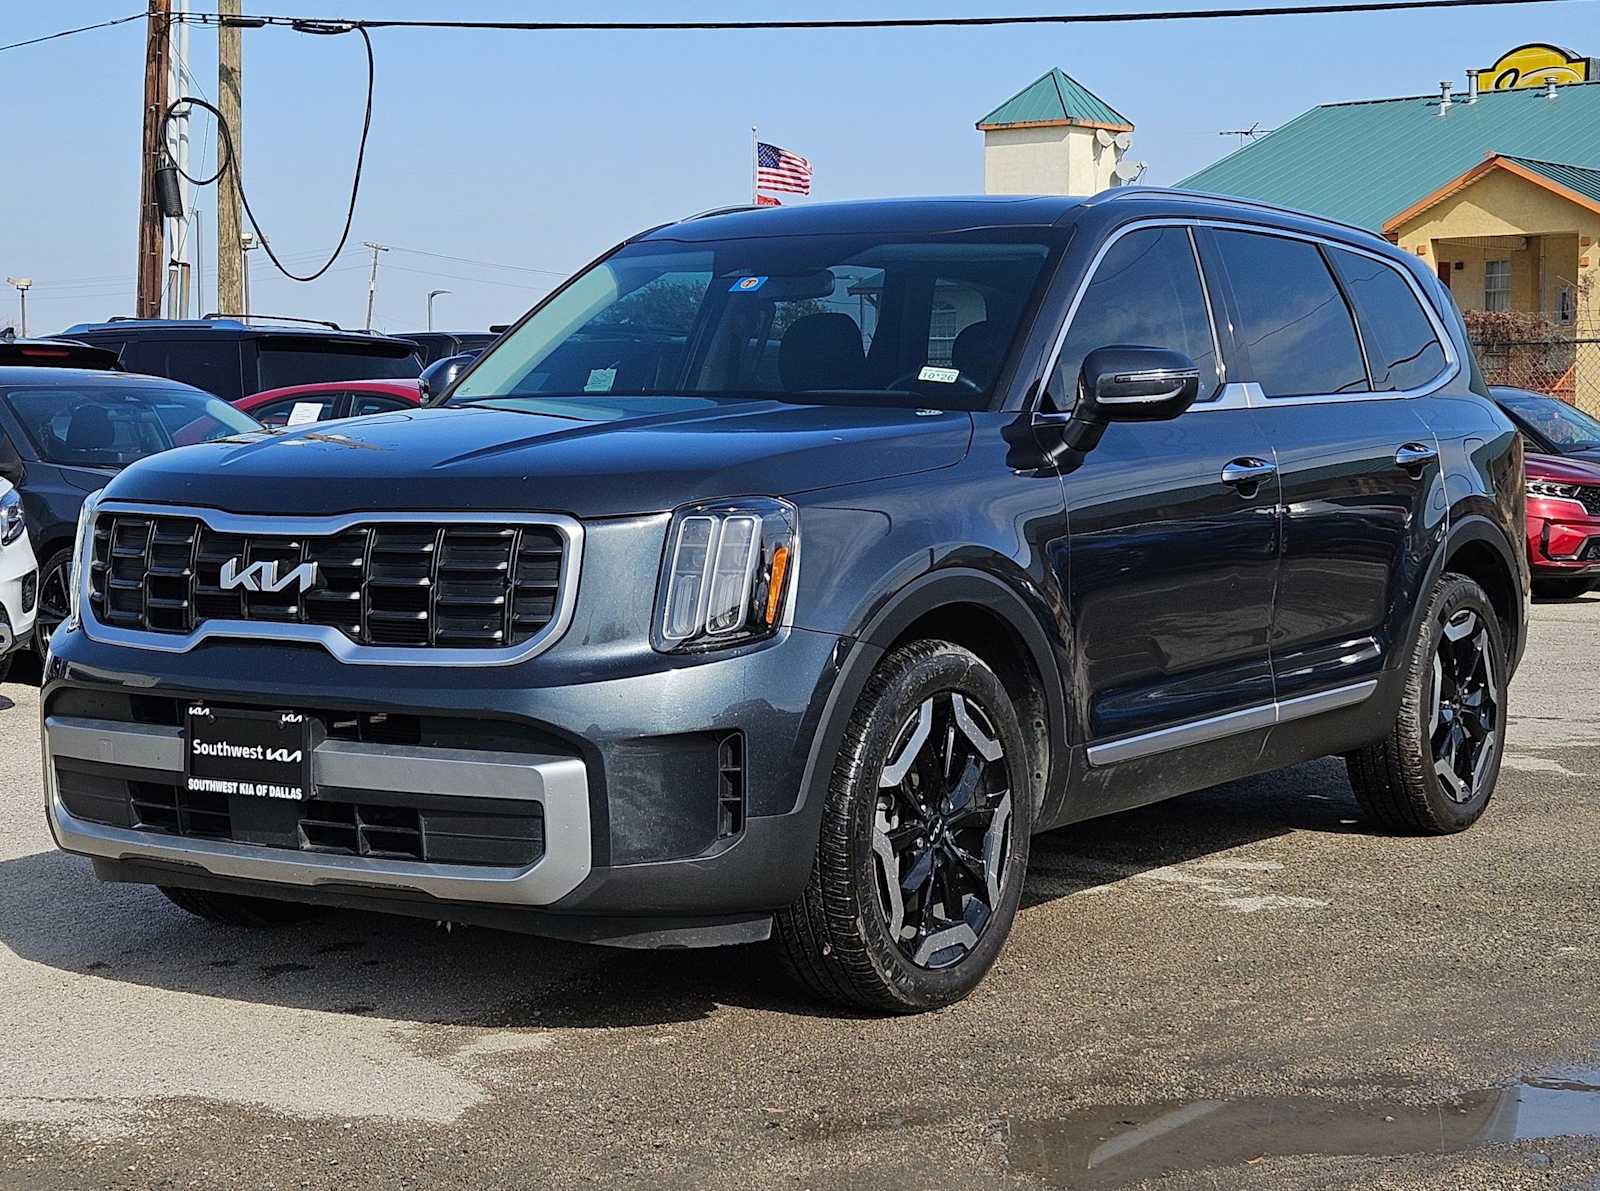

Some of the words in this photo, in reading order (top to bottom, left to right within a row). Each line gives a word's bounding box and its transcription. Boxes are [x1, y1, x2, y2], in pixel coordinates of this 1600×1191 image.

[220, 557, 318, 593] KIA
[193, 739, 263, 760] Southwest
[266, 748, 302, 763] KIA
[188, 778, 238, 794] SOUTHWEST
[239, 783, 255, 796] KIA
[256, 784, 268, 797] OF
[269, 786, 303, 800] DALLAS
